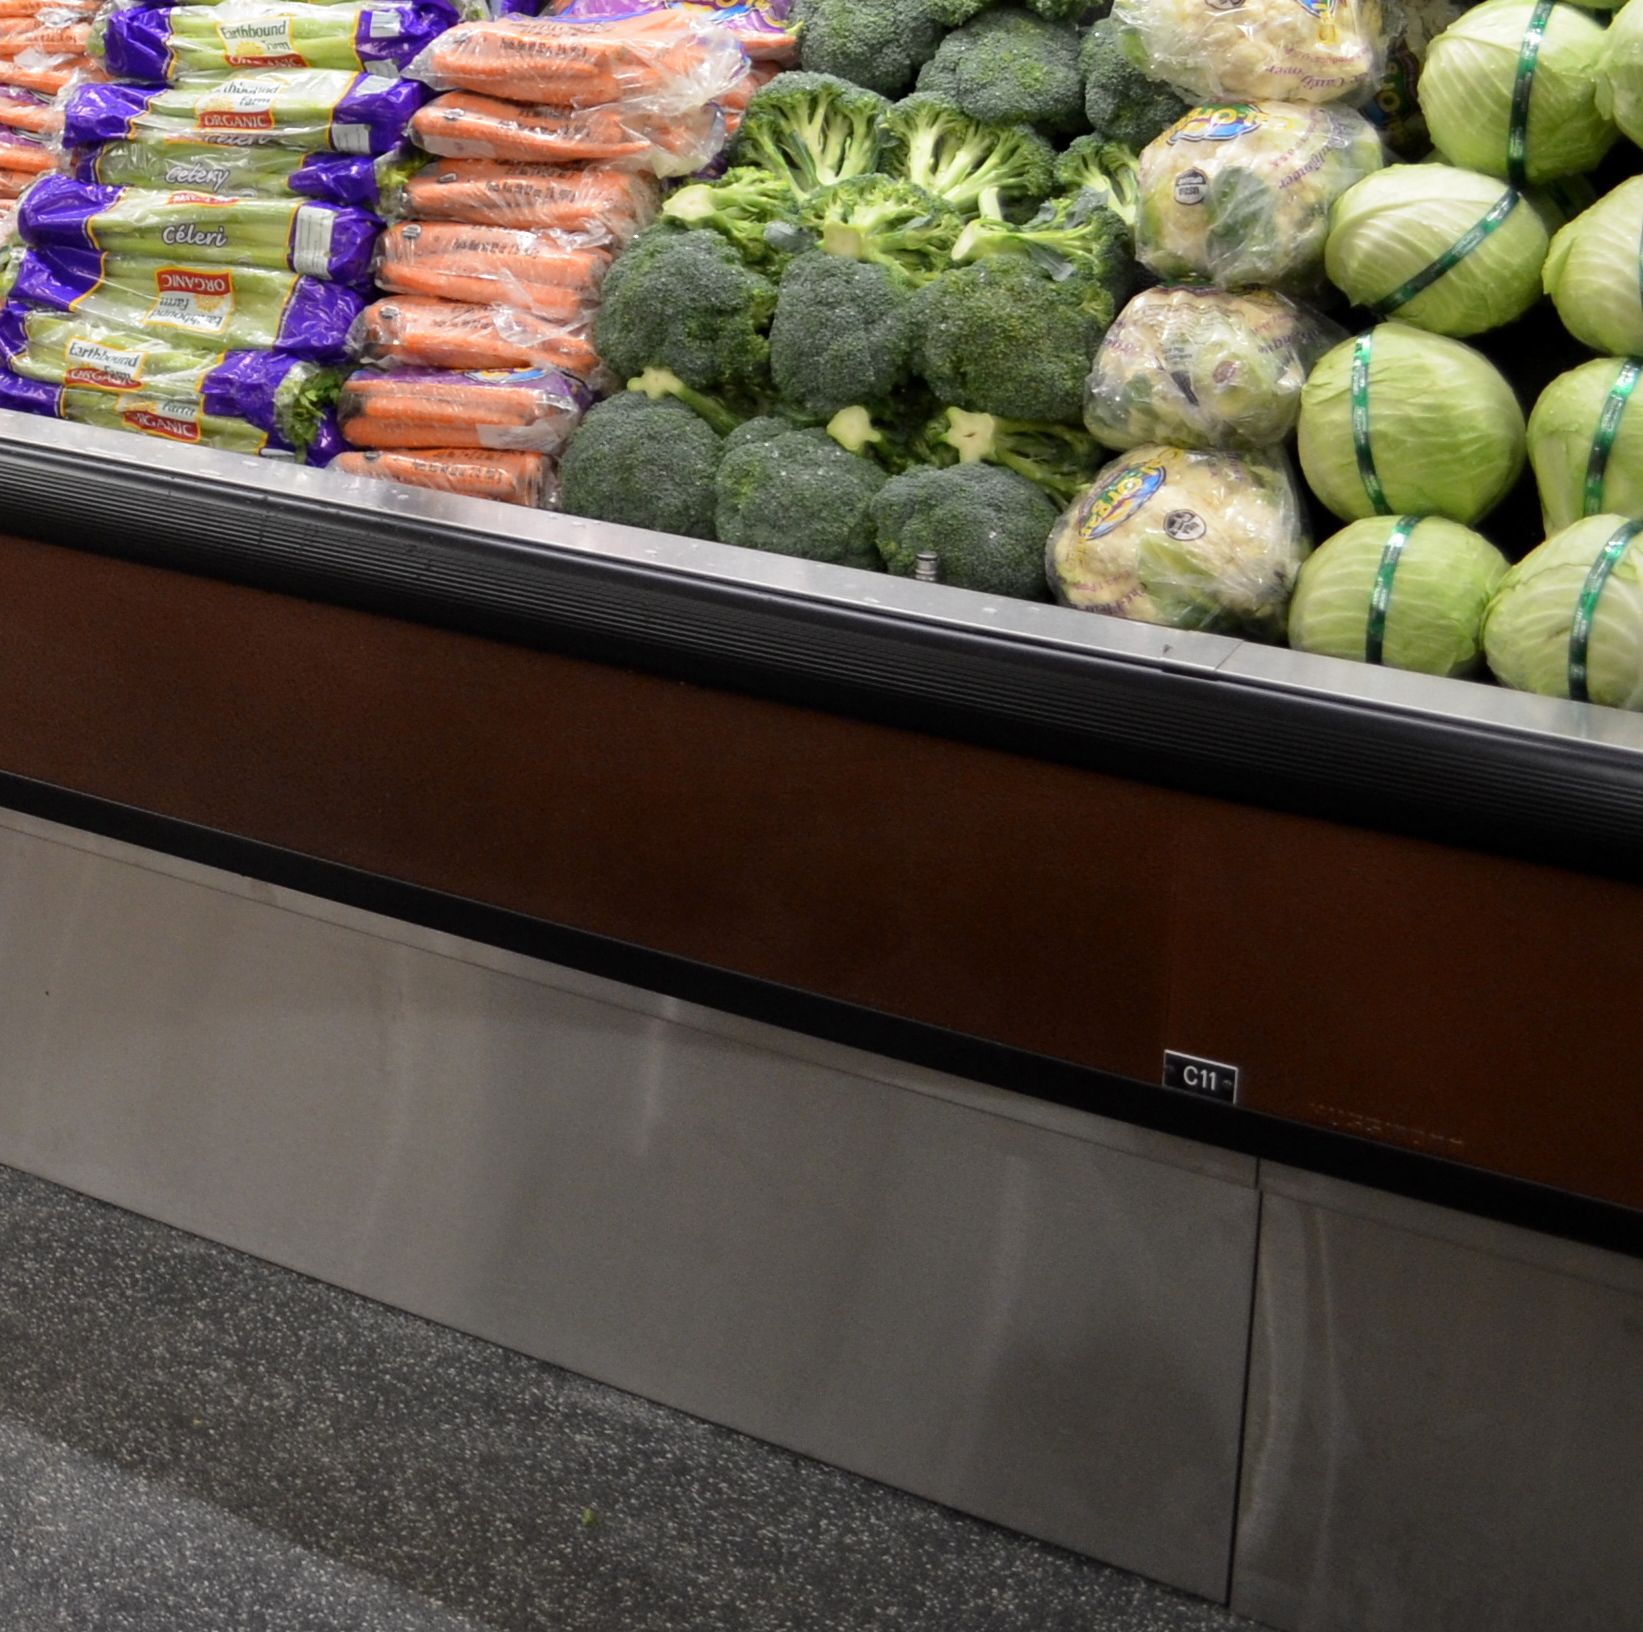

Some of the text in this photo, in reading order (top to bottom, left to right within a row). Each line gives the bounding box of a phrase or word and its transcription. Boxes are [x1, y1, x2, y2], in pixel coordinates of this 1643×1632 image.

[220, 20, 286, 39] Earthbound
[204, 116, 266, 127] ORGANIC
[161, 223, 227, 248] Céleri
[161, 274, 226, 292] ORGANIC
[68, 343, 140, 368] Earthbound
[1183, 1066, 1217, 1090] C11
